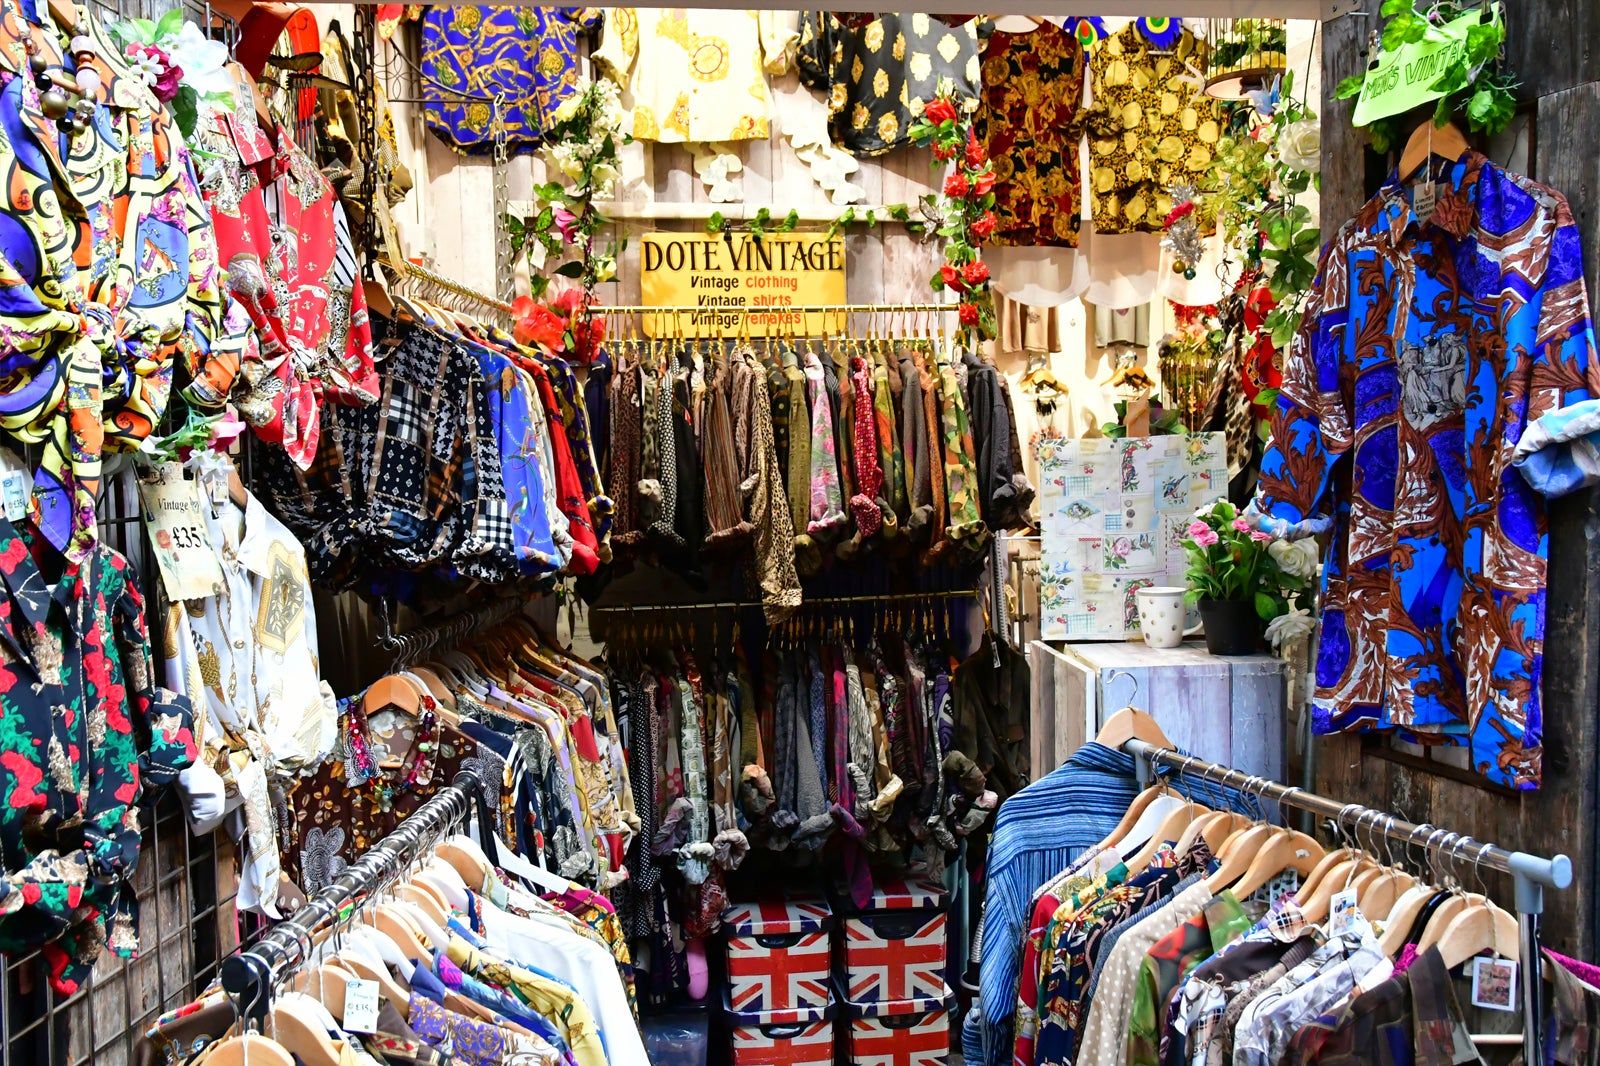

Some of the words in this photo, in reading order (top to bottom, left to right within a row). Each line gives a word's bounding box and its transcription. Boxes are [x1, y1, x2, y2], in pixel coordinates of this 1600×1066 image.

[643, 240, 721, 272] DOTE
[724, 235, 844, 272] VINTAGE
[690, 275, 740, 292] Vintage
[745, 275, 798, 292] clothing
[697, 294, 746, 307] Vintage
[752, 294, 792, 307] shirts
[690, 312, 740, 329] Vintage
[745, 312, 801, 325] remakes
[158, 497, 189, 513] Vintage
[172, 526, 202, 548] £35
